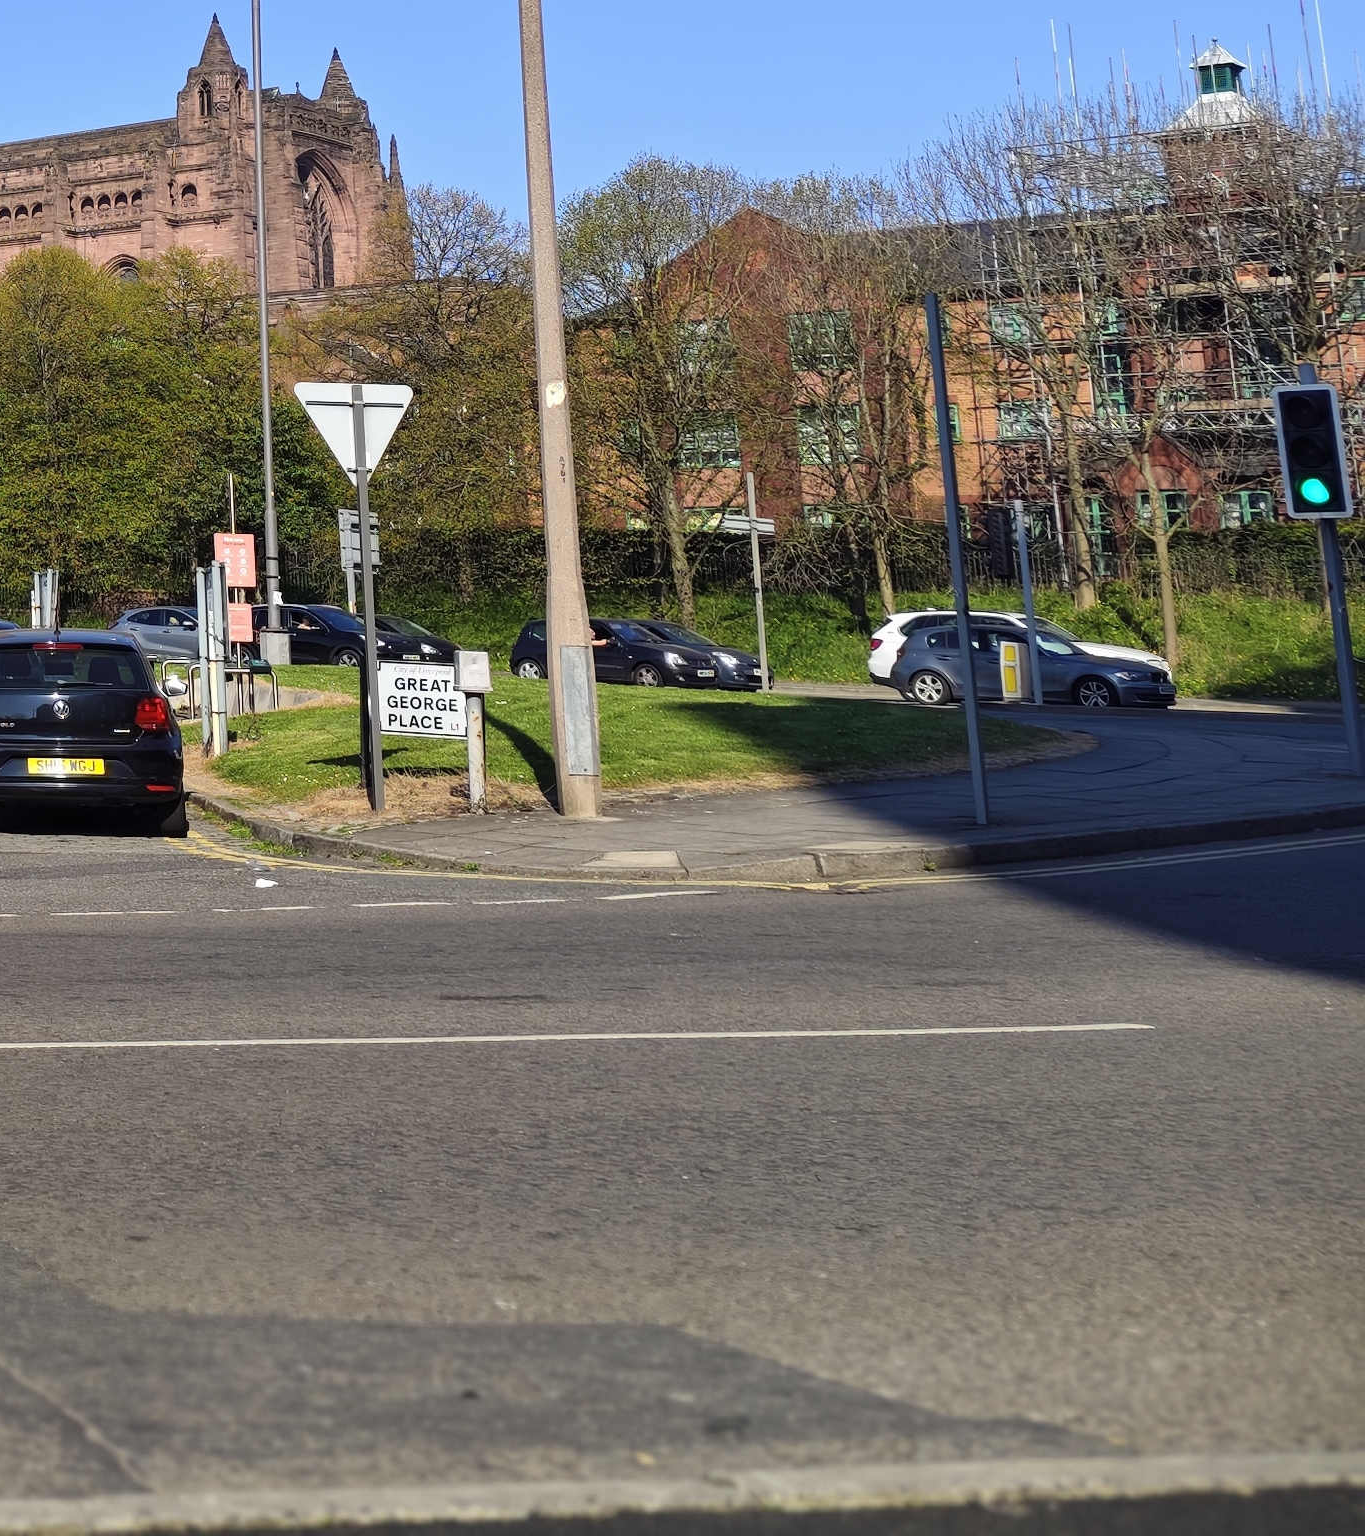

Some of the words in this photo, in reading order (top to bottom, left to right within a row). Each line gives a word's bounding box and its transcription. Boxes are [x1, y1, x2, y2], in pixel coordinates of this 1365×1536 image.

[395, 678, 451, 692] GREAT
[387, 695, 459, 712] GEORGE
[388, 714, 443, 730] PLACE
[450, 723, 459, 731] L1
[69, 760, 95, 772] WGJ
